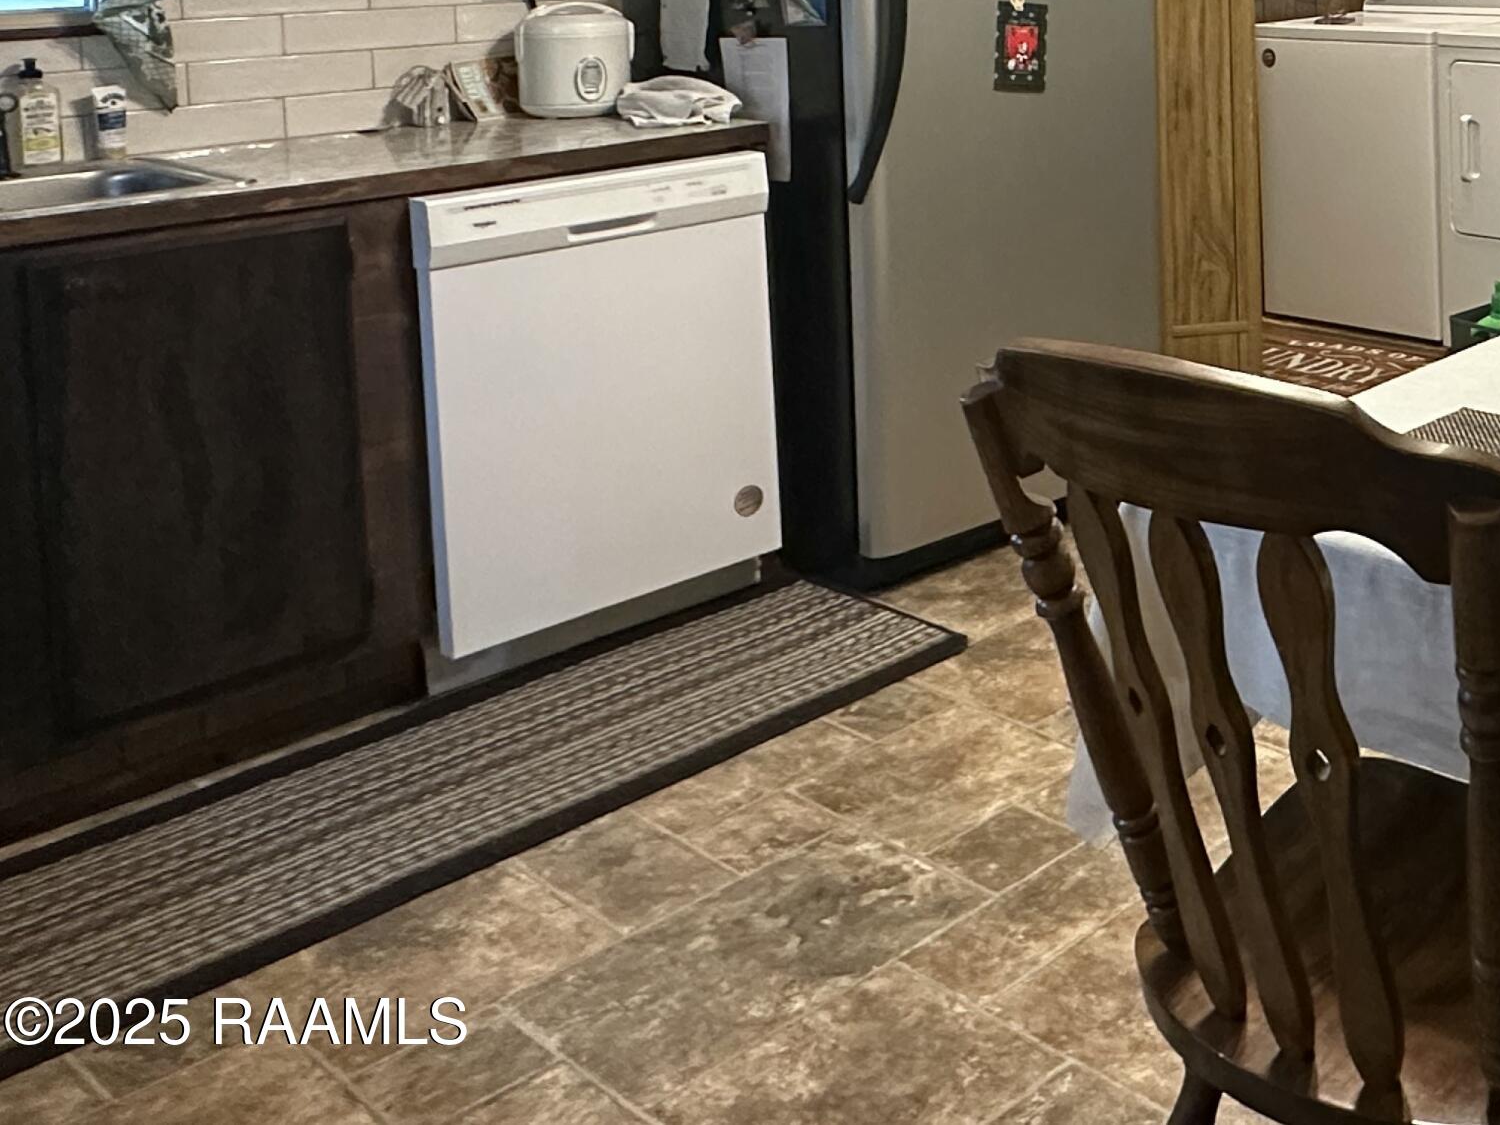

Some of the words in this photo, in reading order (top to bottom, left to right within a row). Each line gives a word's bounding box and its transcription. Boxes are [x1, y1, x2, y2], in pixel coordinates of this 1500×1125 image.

[1261, 347, 1385, 384] UNDRY
[1287, 339, 1385, 355] LOADS
[1388, 352, 1426, 363] OF
